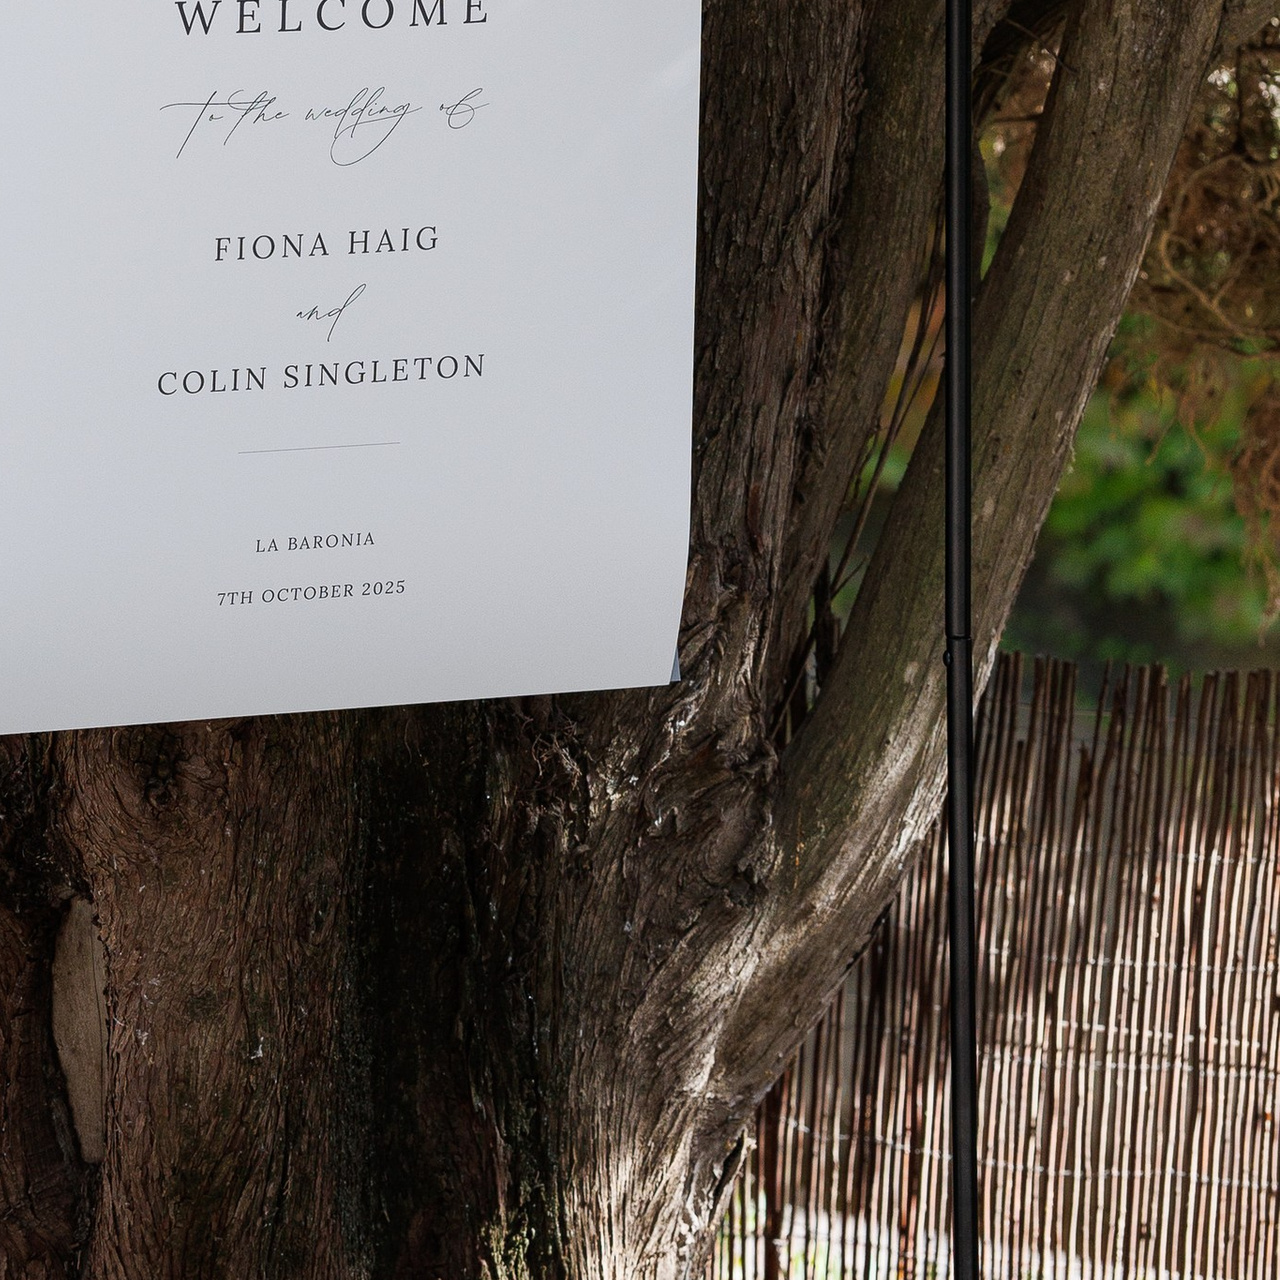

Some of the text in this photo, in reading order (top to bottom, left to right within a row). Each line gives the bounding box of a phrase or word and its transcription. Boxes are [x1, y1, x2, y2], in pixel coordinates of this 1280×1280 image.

[223, 88, 290, 146] the
[304, 86, 423, 167] wedding
[438, 87, 490, 130] of
[214, 225, 439, 262] FIONA HAIG
[296, 283, 367, 342] and
[157, 353, 486, 396] COLIN SINGLETON
[255, 531, 376, 554] LA BARONIA
[217, 579, 407, 607] 7TH OCTOBER 2025
